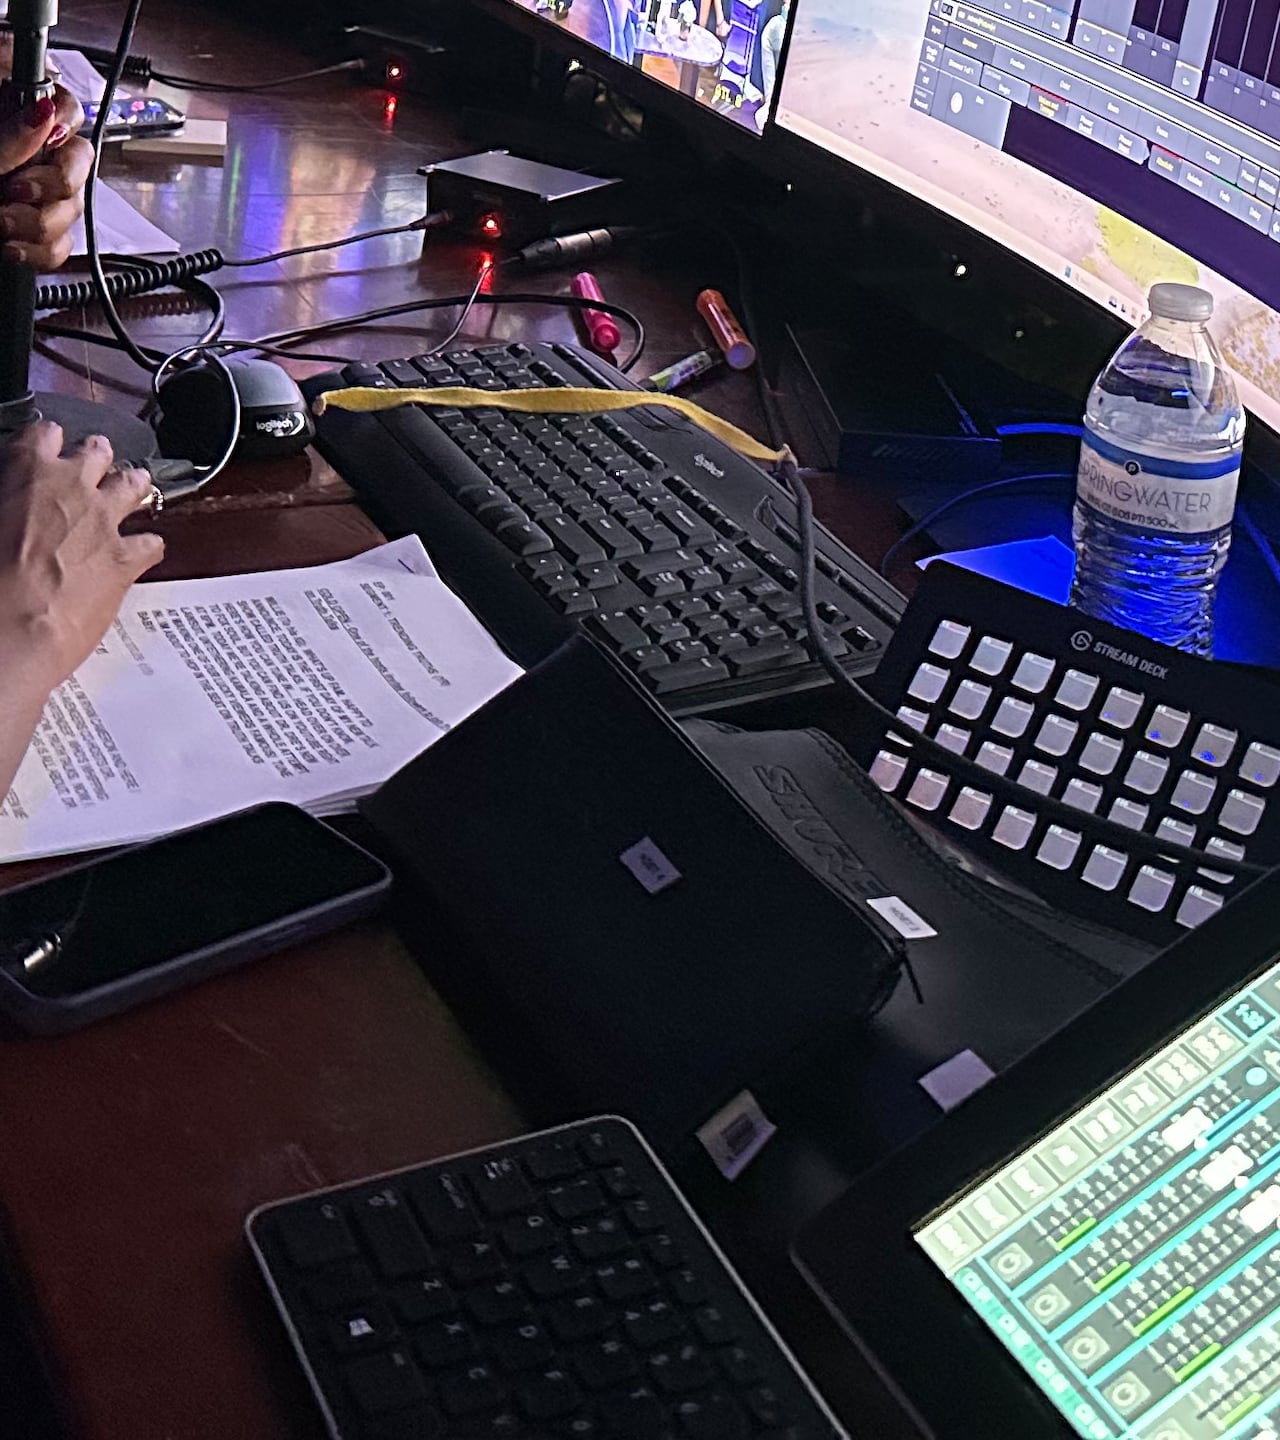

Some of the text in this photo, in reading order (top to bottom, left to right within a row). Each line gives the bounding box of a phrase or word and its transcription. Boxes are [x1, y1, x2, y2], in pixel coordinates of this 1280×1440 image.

[1093, 641, 1169, 679] STREAM DECK
[752, 764, 891, 896] SHURE
